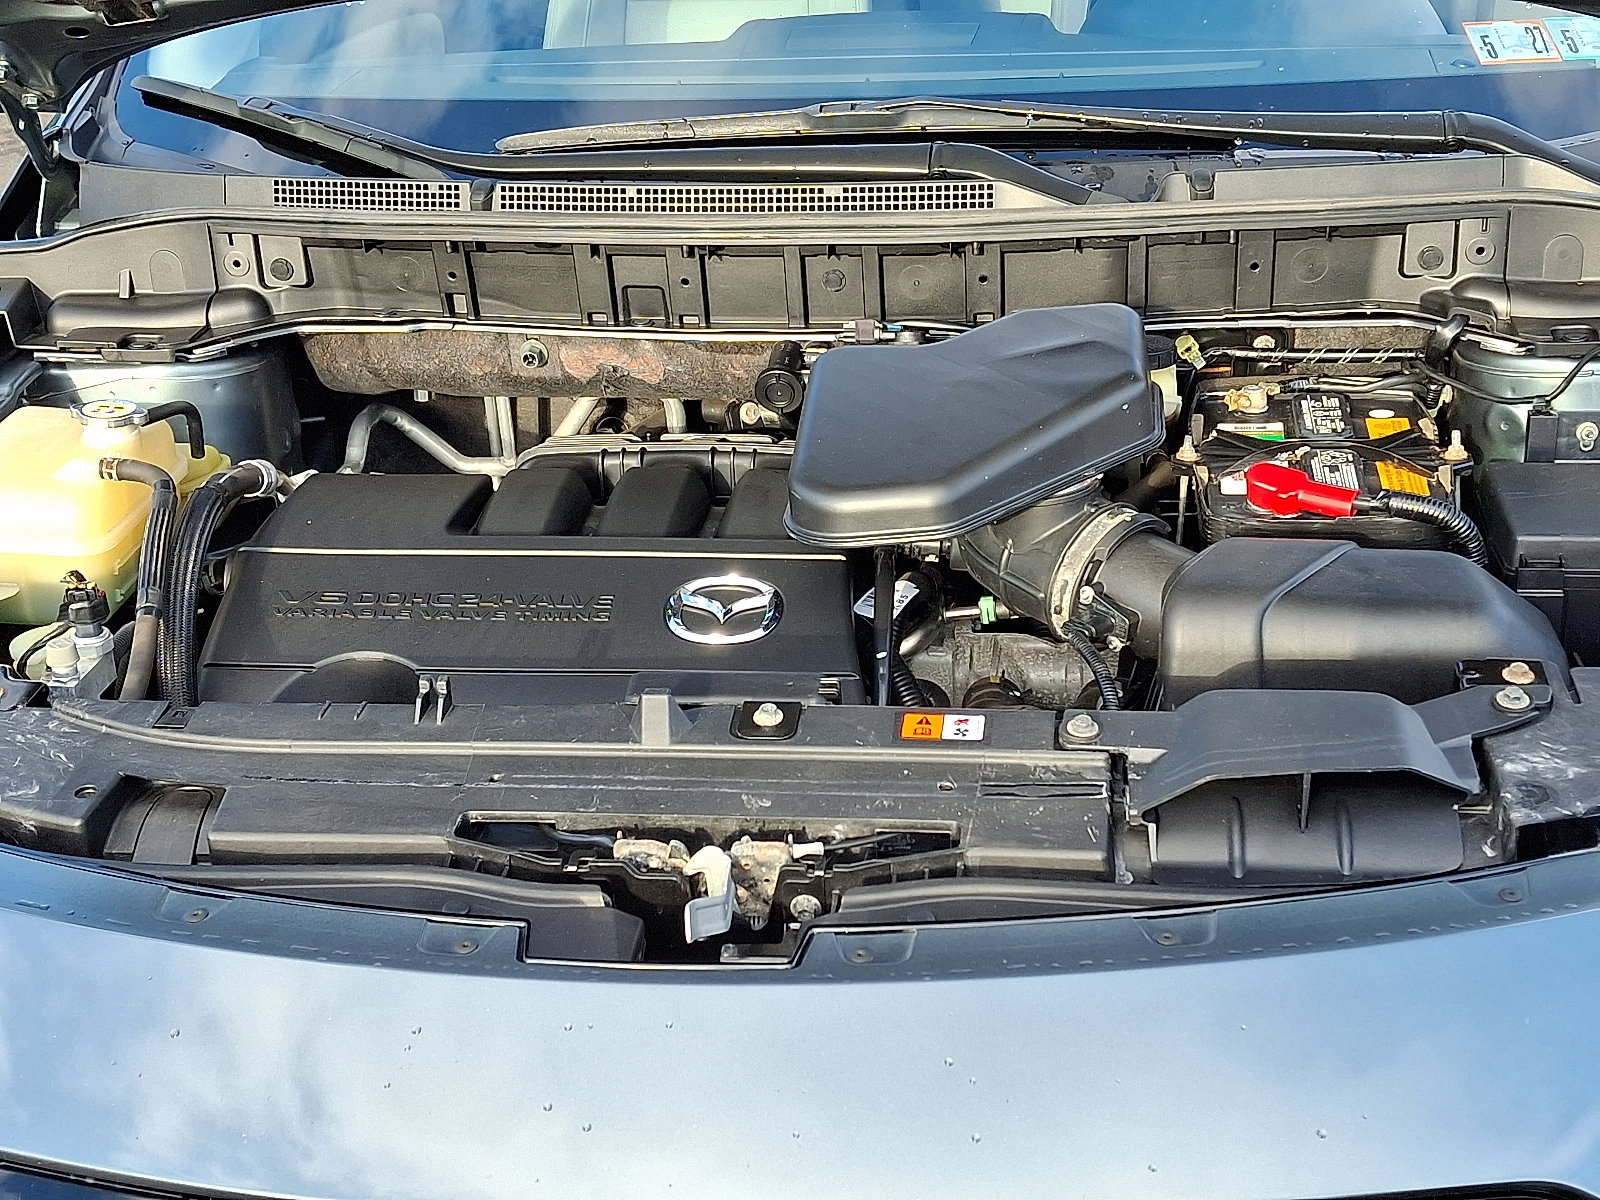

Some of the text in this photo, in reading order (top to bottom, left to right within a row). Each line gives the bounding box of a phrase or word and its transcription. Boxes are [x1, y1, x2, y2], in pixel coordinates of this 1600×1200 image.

[1480, 35, 1499, 59] 5
[1524, 26, 1549, 54] 27
[1560, 29, 1580, 53] 5
[352, 591, 455, 608] DOHC
[273, 607, 611, 622] VARIABLE VALVE TIMING
